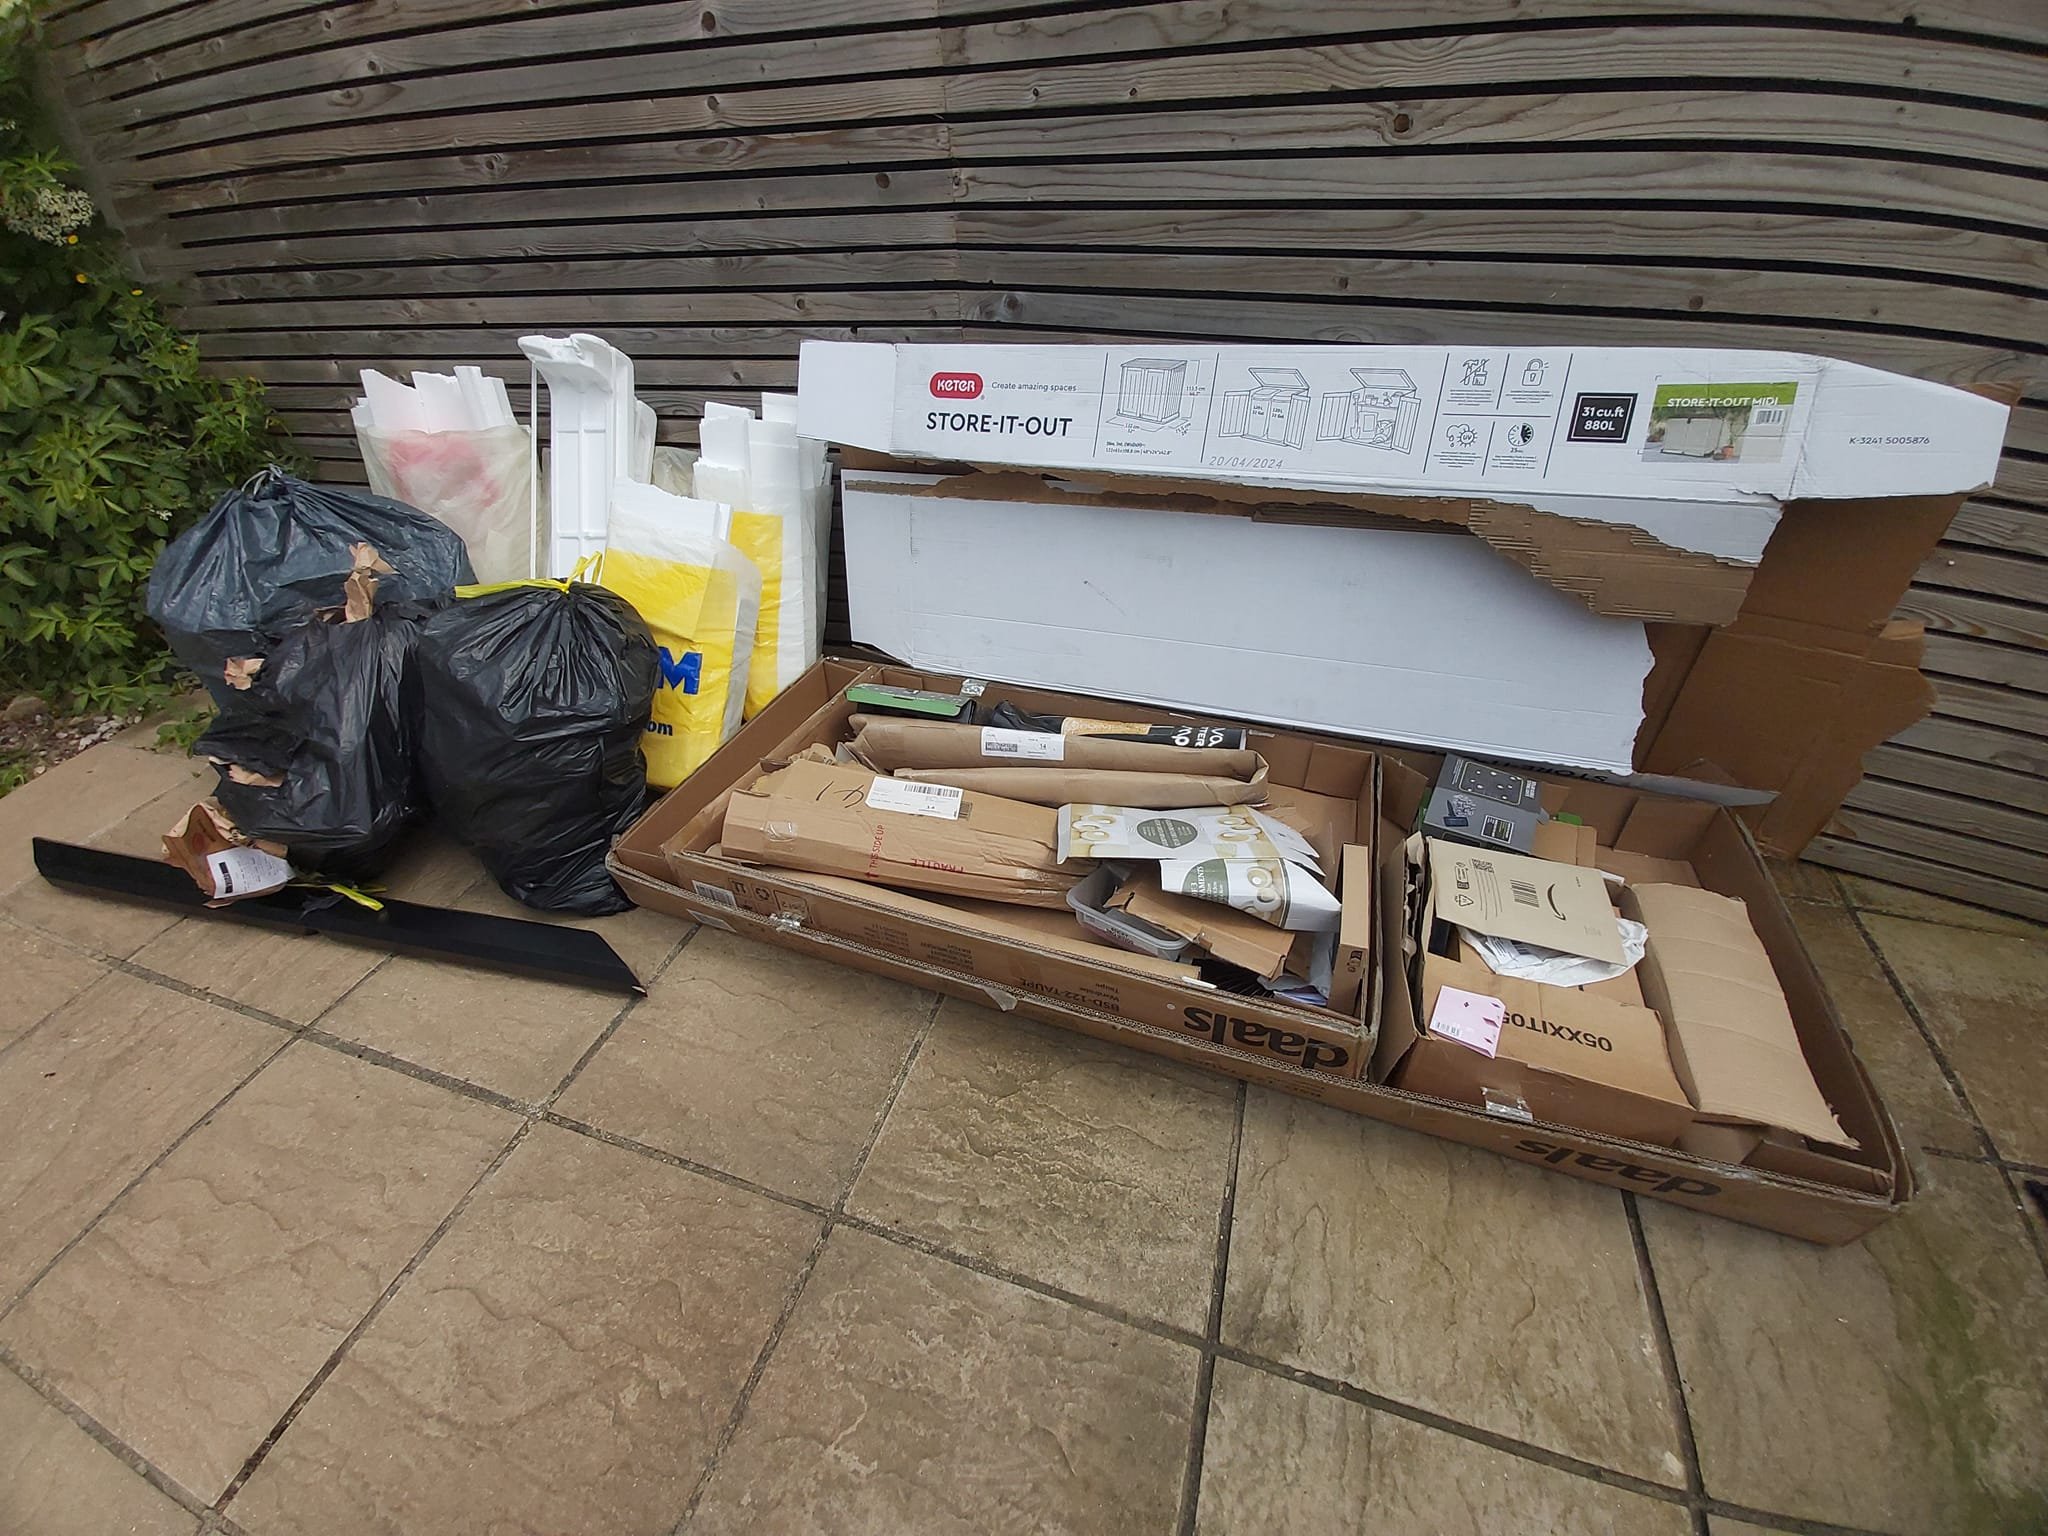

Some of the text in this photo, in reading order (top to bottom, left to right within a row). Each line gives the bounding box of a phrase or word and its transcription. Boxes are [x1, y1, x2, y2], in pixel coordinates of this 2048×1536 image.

[936, 379, 975, 393] KETER
[991, 381, 1077, 393] Create amazing spaces
[1667, 397, 1779, 408] STORE-IT-OUT MIDI
[1582, 405, 1625, 418] 31 cu.ft
[926, 412, 1073, 437] STORE-IT-OUT
[1584, 420, 1616, 431] 880L
[1849, 436, 1930, 445] K-3241 5005876
[1209, 456, 1283, 470] 20/04/2024
[658, 646, 703, 695] M
[876, 824, 885, 835] UP
[872, 836, 882, 854] SIDE
[1183, 1006, 1349, 1070] daals
[1514, 1139, 1722, 1197] daals
